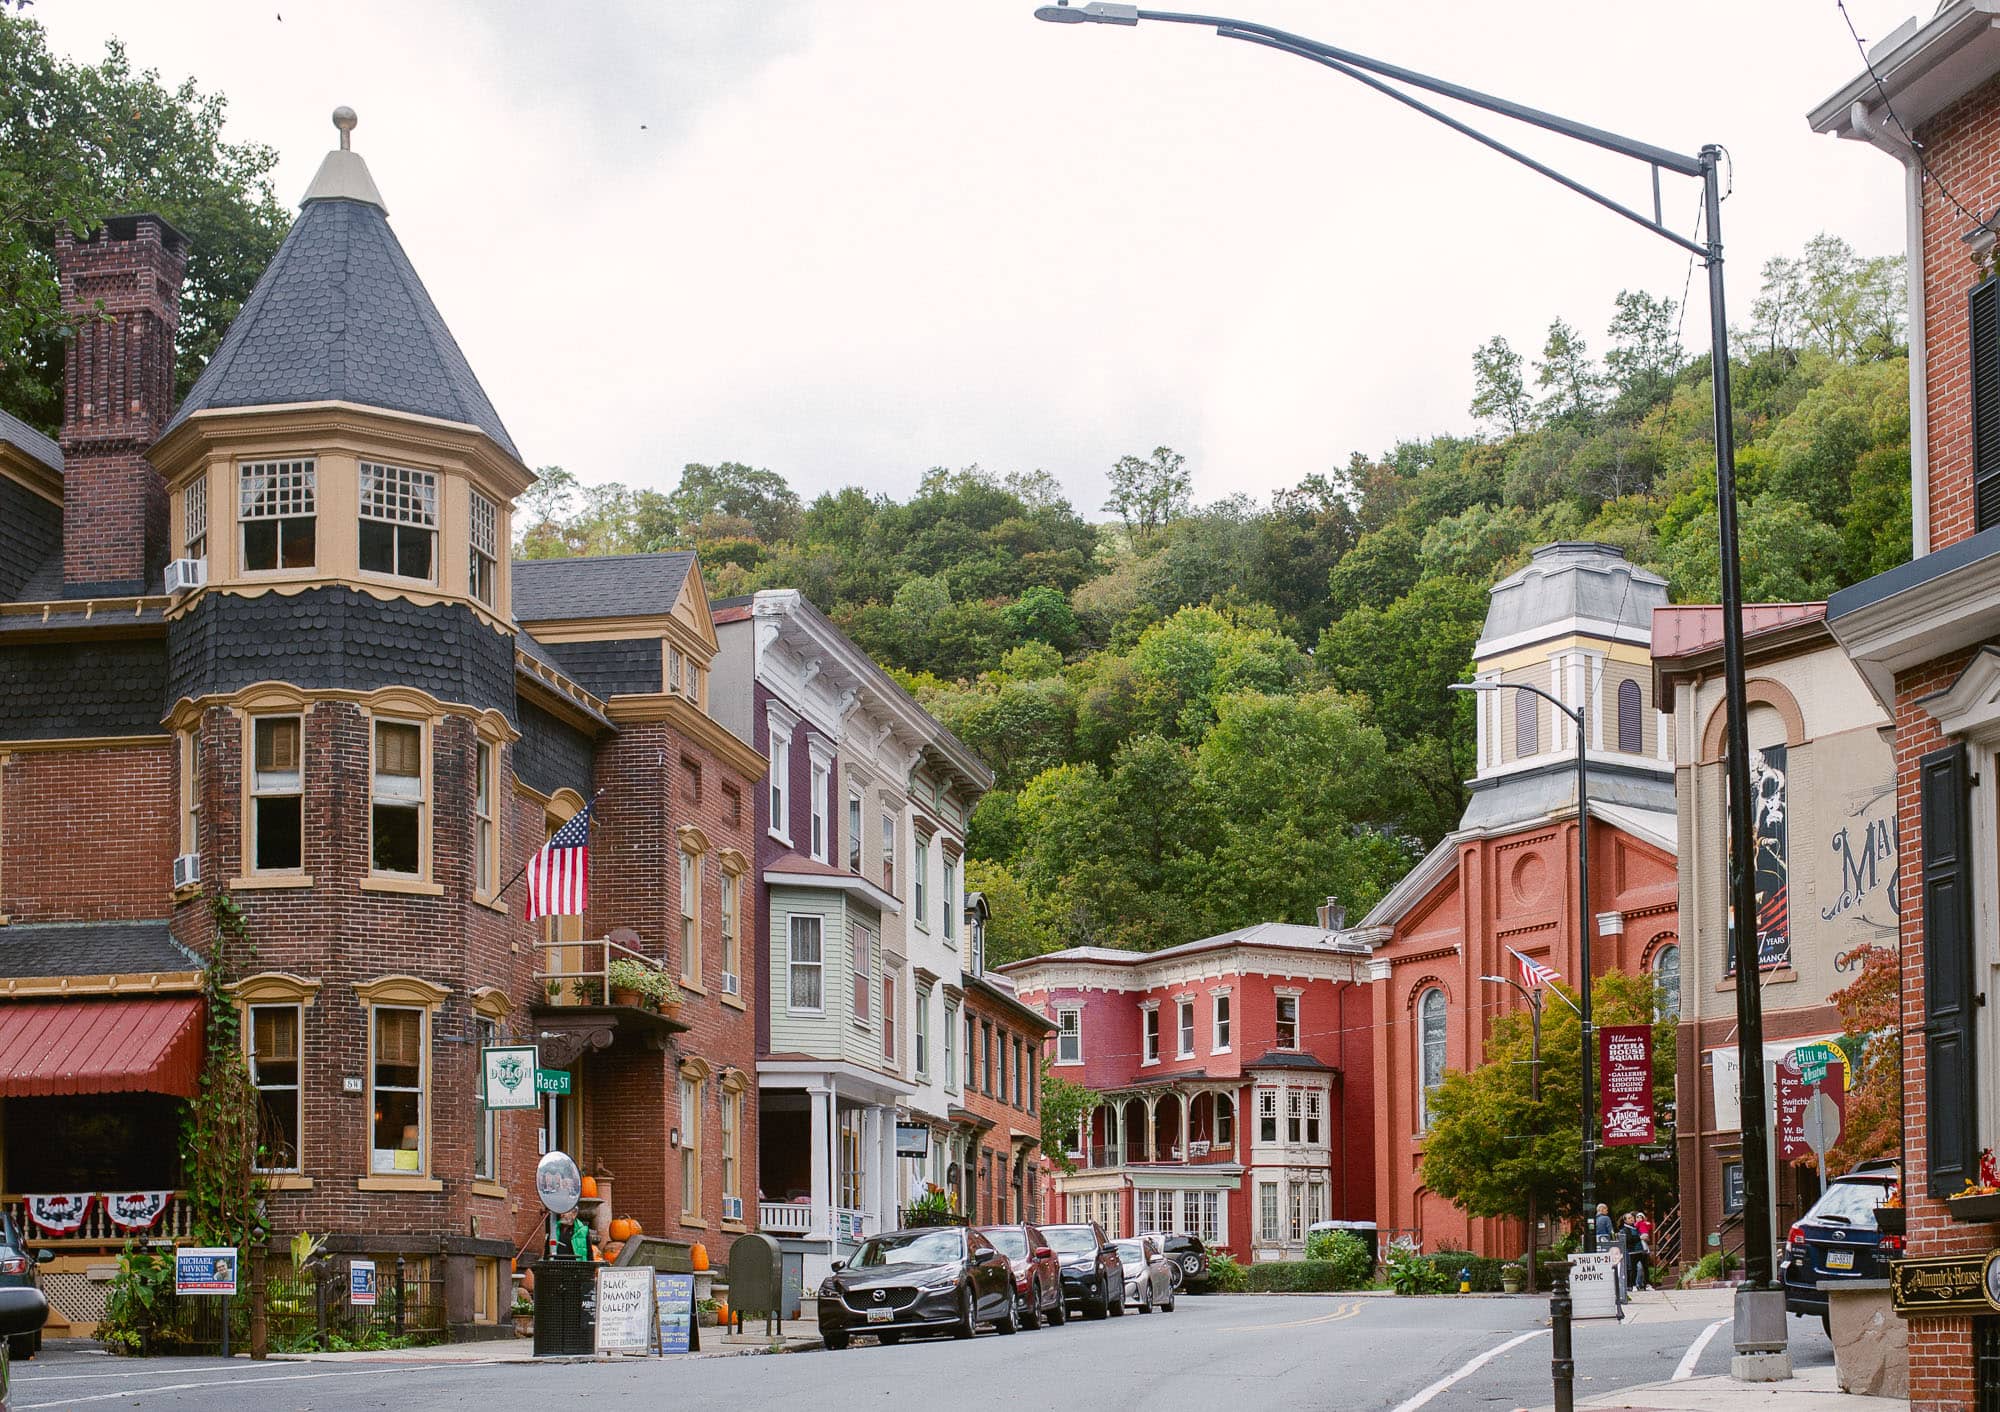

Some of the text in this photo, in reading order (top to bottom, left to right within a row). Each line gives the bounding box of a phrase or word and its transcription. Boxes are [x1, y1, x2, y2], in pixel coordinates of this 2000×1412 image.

[1766, 936, 1785, 946] YEARS
[1611, 1034, 1637, 1043] Welcome
[1797, 1048, 1815, 1063] Hill
[1818, 1051, 1828, 1061] Rd
[536, 1072, 569, 1090] Race ST
[1781, 1078, 1799, 1086] Race
[1617, 1093, 1639, 1101] and the
[1783, 1106, 1797, 1114] Trail
[179, 1257, 213, 1265] MICHAEL
[1578, 1256, 1591, 1265] THU
[182, 1264, 209, 1273] RIVKIN
[1574, 1272, 1604, 1281] POPOVIC
[1954, 1266, 1980, 1286] House
[602, 1280, 628, 1289] BLACK
[602, 1290, 642, 1301] DIAMOND
[602, 1302, 640, 1313] GALLERY
